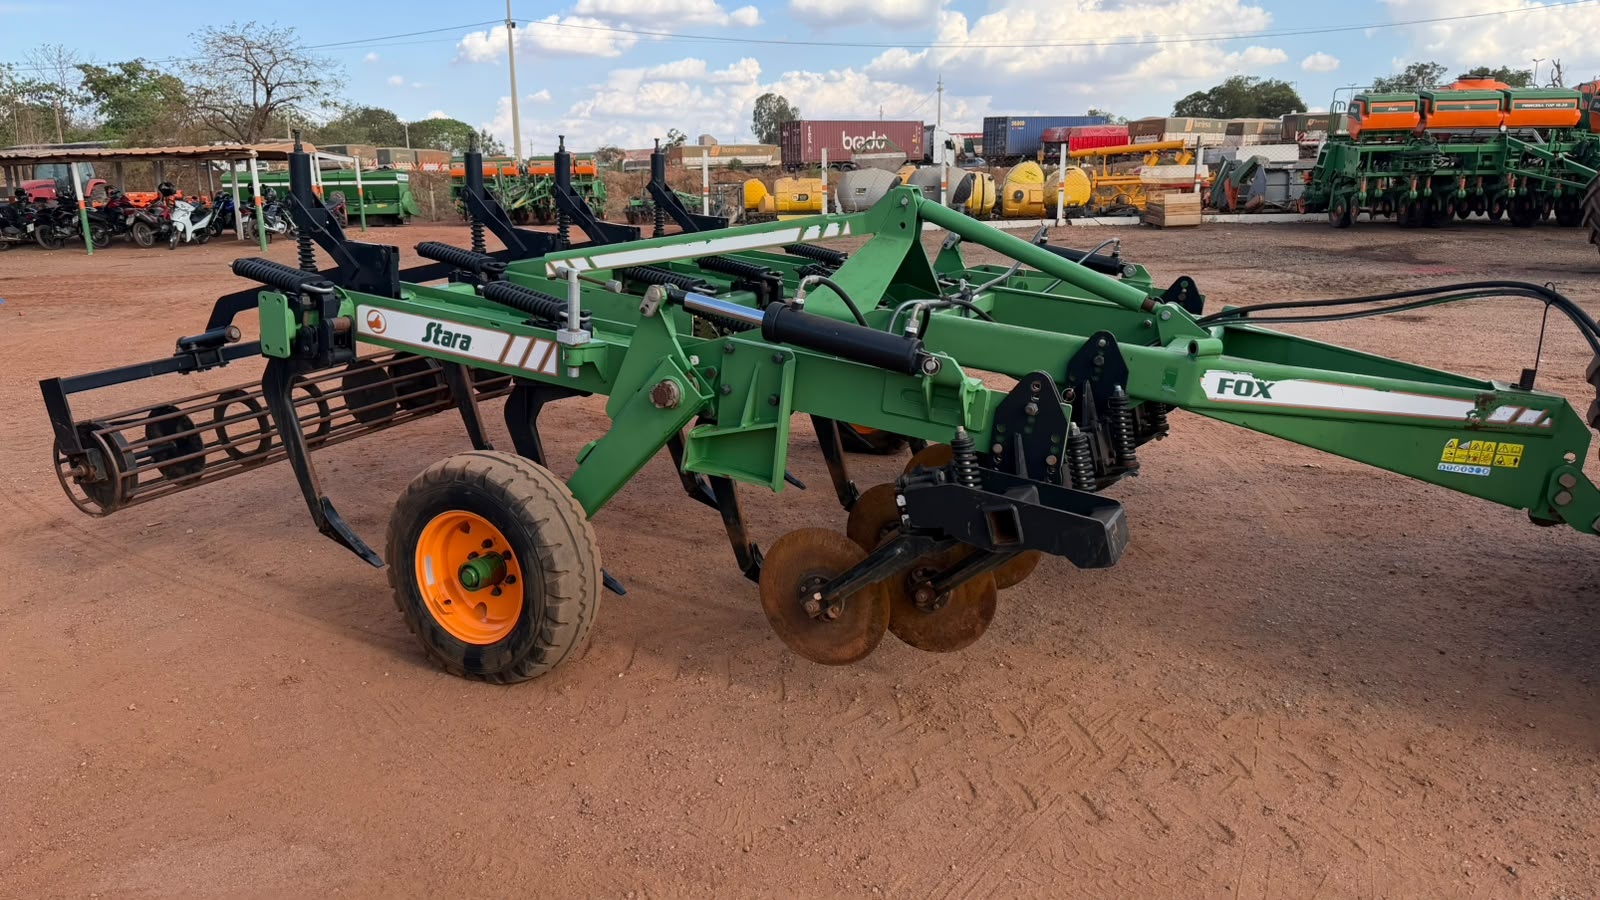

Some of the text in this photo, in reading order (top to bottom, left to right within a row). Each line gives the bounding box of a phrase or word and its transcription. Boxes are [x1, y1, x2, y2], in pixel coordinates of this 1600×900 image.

[842, 130, 887, 150] brado
[421, 321, 472, 352] Stara
[1216, 377, 1276, 400] FOX
